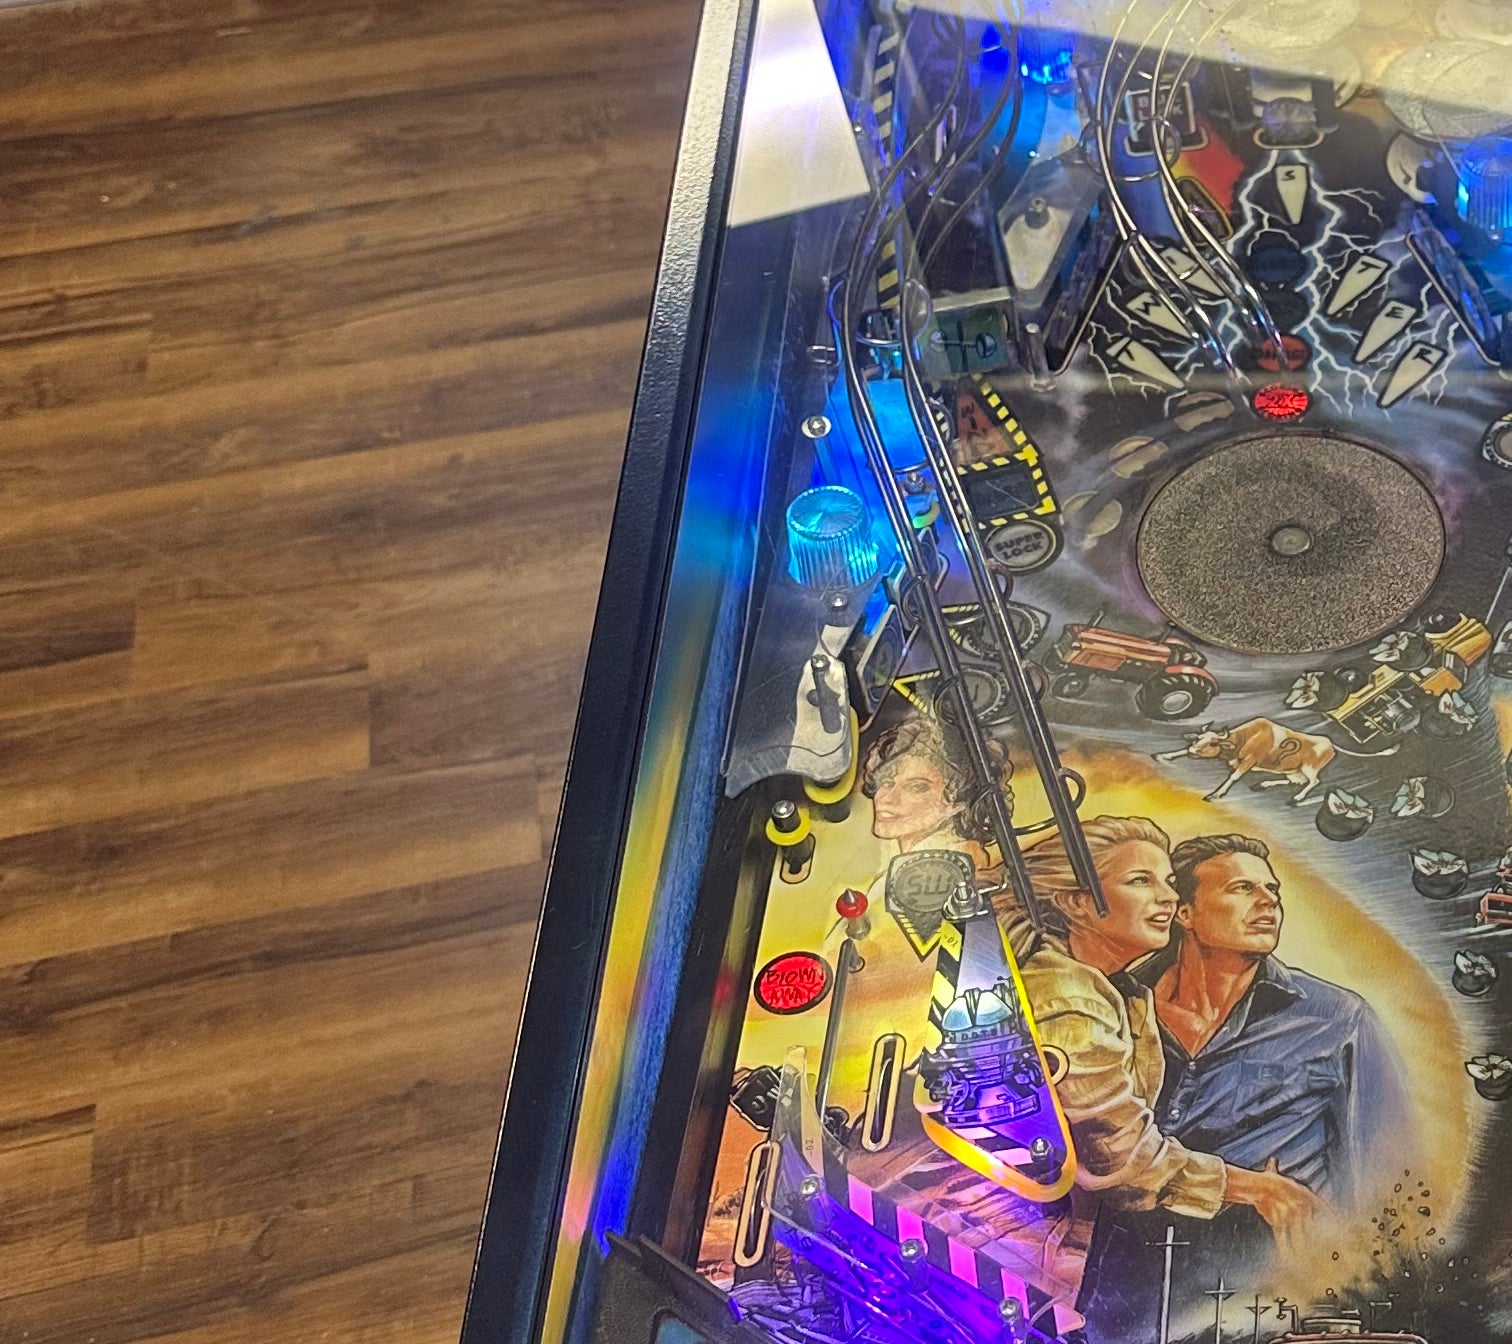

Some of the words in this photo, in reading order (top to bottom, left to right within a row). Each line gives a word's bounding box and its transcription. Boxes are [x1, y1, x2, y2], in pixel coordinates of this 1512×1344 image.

[1282, 169, 1296, 181] S
[1359, 261, 1382, 274] T
[1392, 307, 1405, 320] E
[1413, 347, 1433, 363] R
[994, 531, 1044, 552] SUPER
[1002, 541, 1044, 561] LOCK
[764, 967, 824, 986] BLOWN
[769, 982, 820, 1004] AWAY
